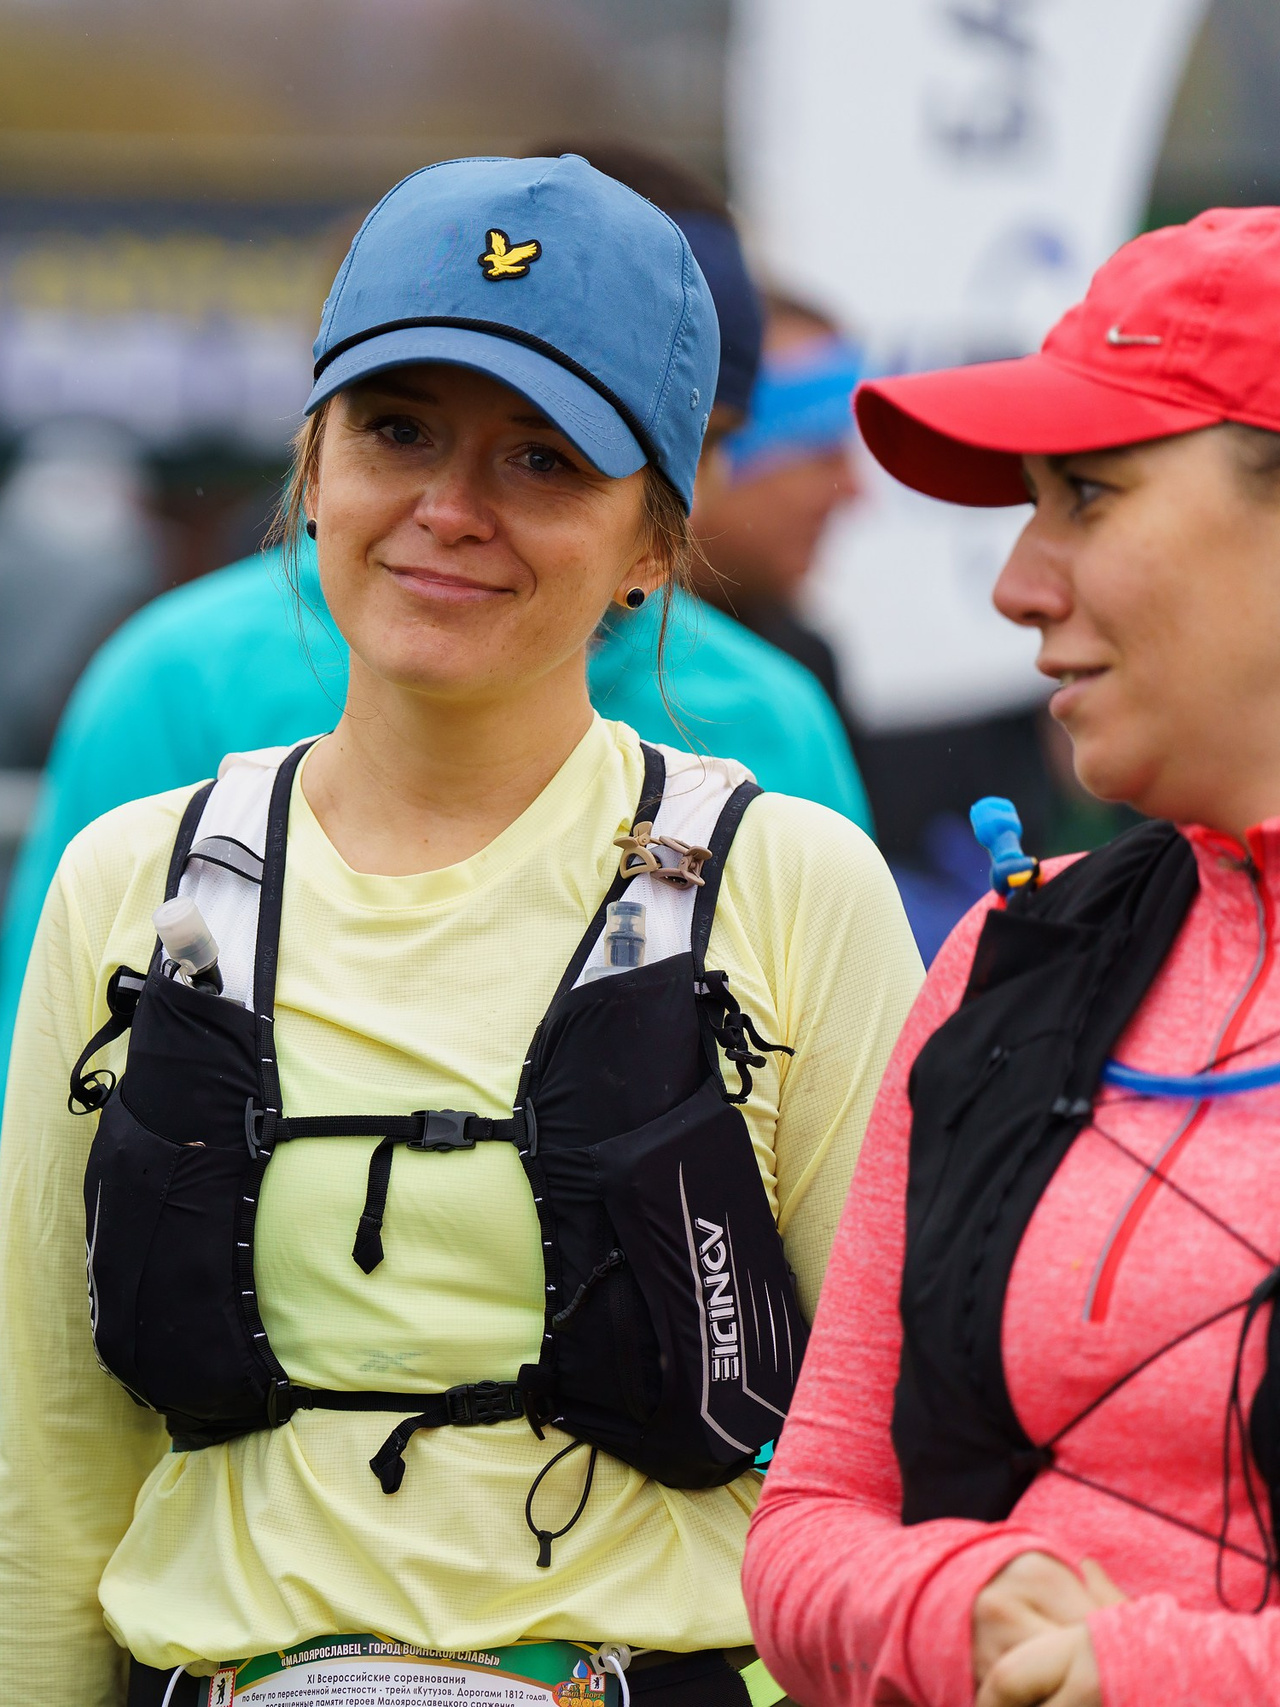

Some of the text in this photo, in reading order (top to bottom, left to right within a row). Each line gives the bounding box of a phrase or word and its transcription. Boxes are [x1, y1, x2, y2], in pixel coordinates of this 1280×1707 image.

[694, 1217, 740, 1382] AONIJIE
[281, 1643, 361, 1667] «МАЛОЯРОСЛАВЕЦ
[368, 1643, 401, 1655] ГОРОД
[457, 1650, 500, 1666] СЛАВЫ»
[306, 1672, 466, 1685] XI Всероссийские соревнования
[241, 1695, 250, 1703] по
[251, 1692, 266, 1702] бегу
[267, 1692, 276, 1700] по
[277, 1686, 329, 1700] пересеченной
[330, 1686, 377, 1695] местности
[385, 1685, 411, 1695] трейл
[413, 1686, 454, 1697] «Кутузов.
[456, 1687, 502, 1699] Дорогами
[504, 1690, 524, 1699] 1812
[315, 1699, 344, 1707] памяти
[345, 1697, 375, 1707] героев
